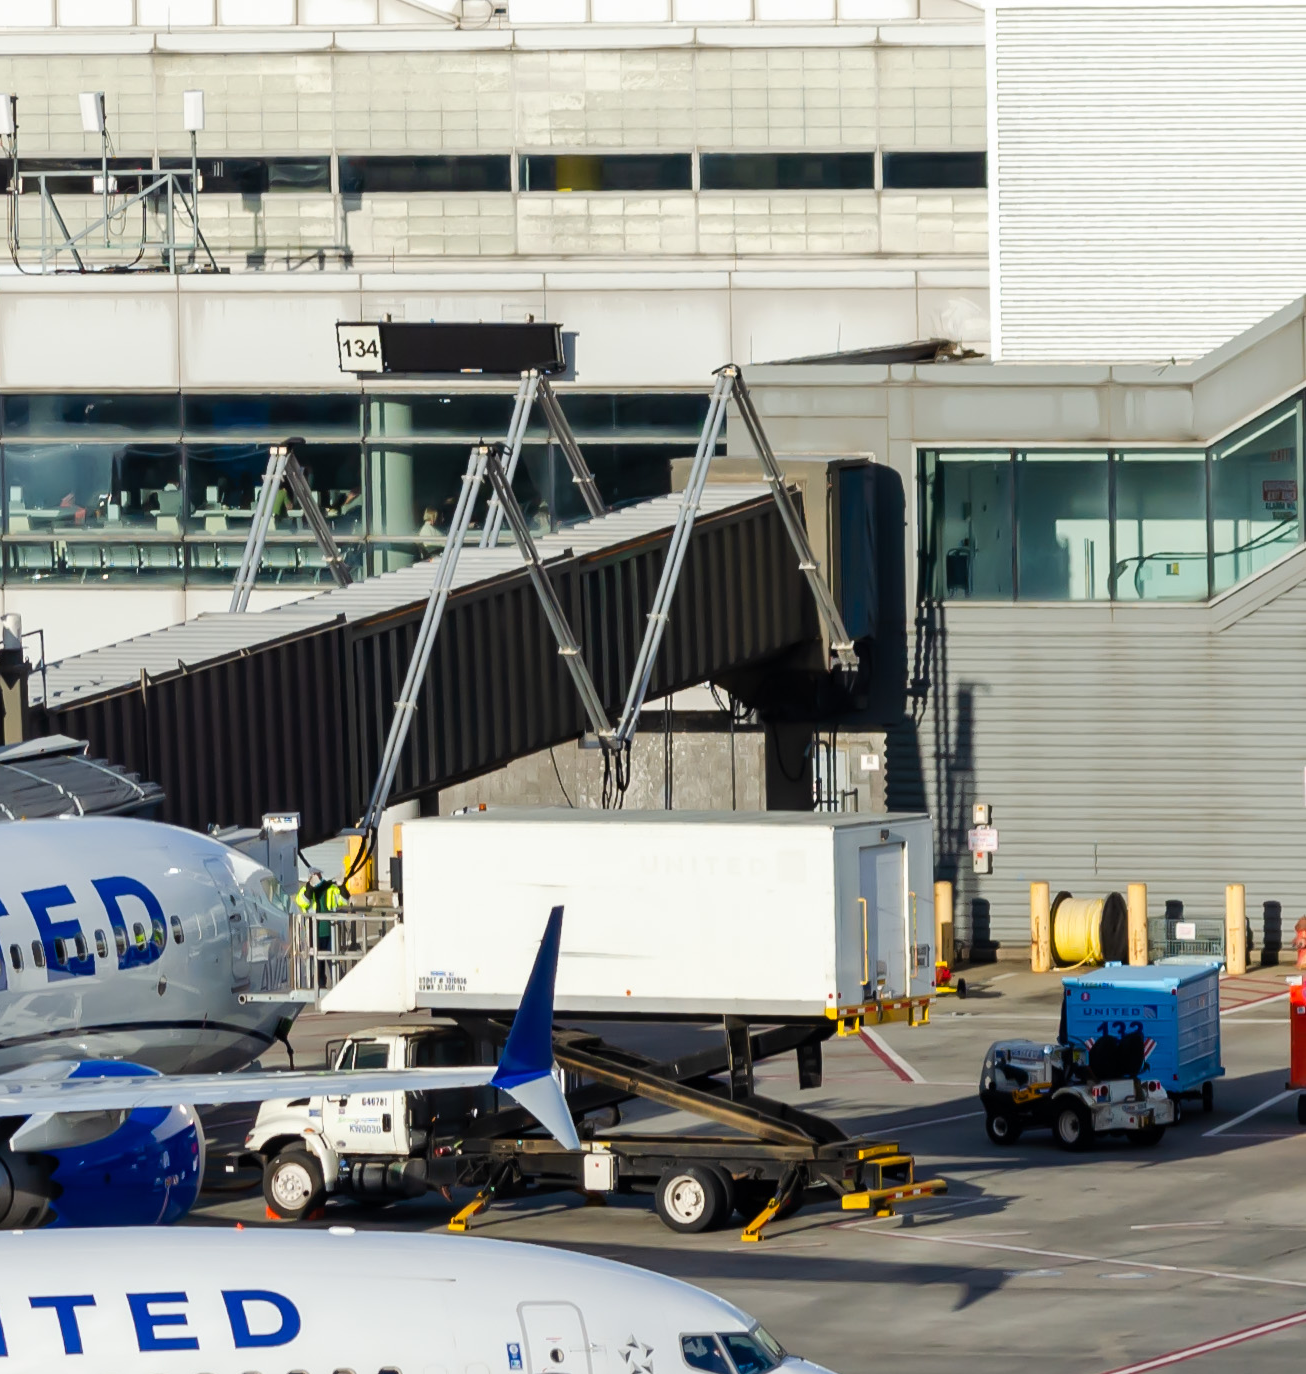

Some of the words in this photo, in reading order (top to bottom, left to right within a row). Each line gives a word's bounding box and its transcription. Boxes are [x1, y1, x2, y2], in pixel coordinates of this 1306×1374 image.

[343, 340, 378, 358] 134
[640, 854, 766, 875] UNITED
[1083, 1007, 1140, 1016] UNITED
